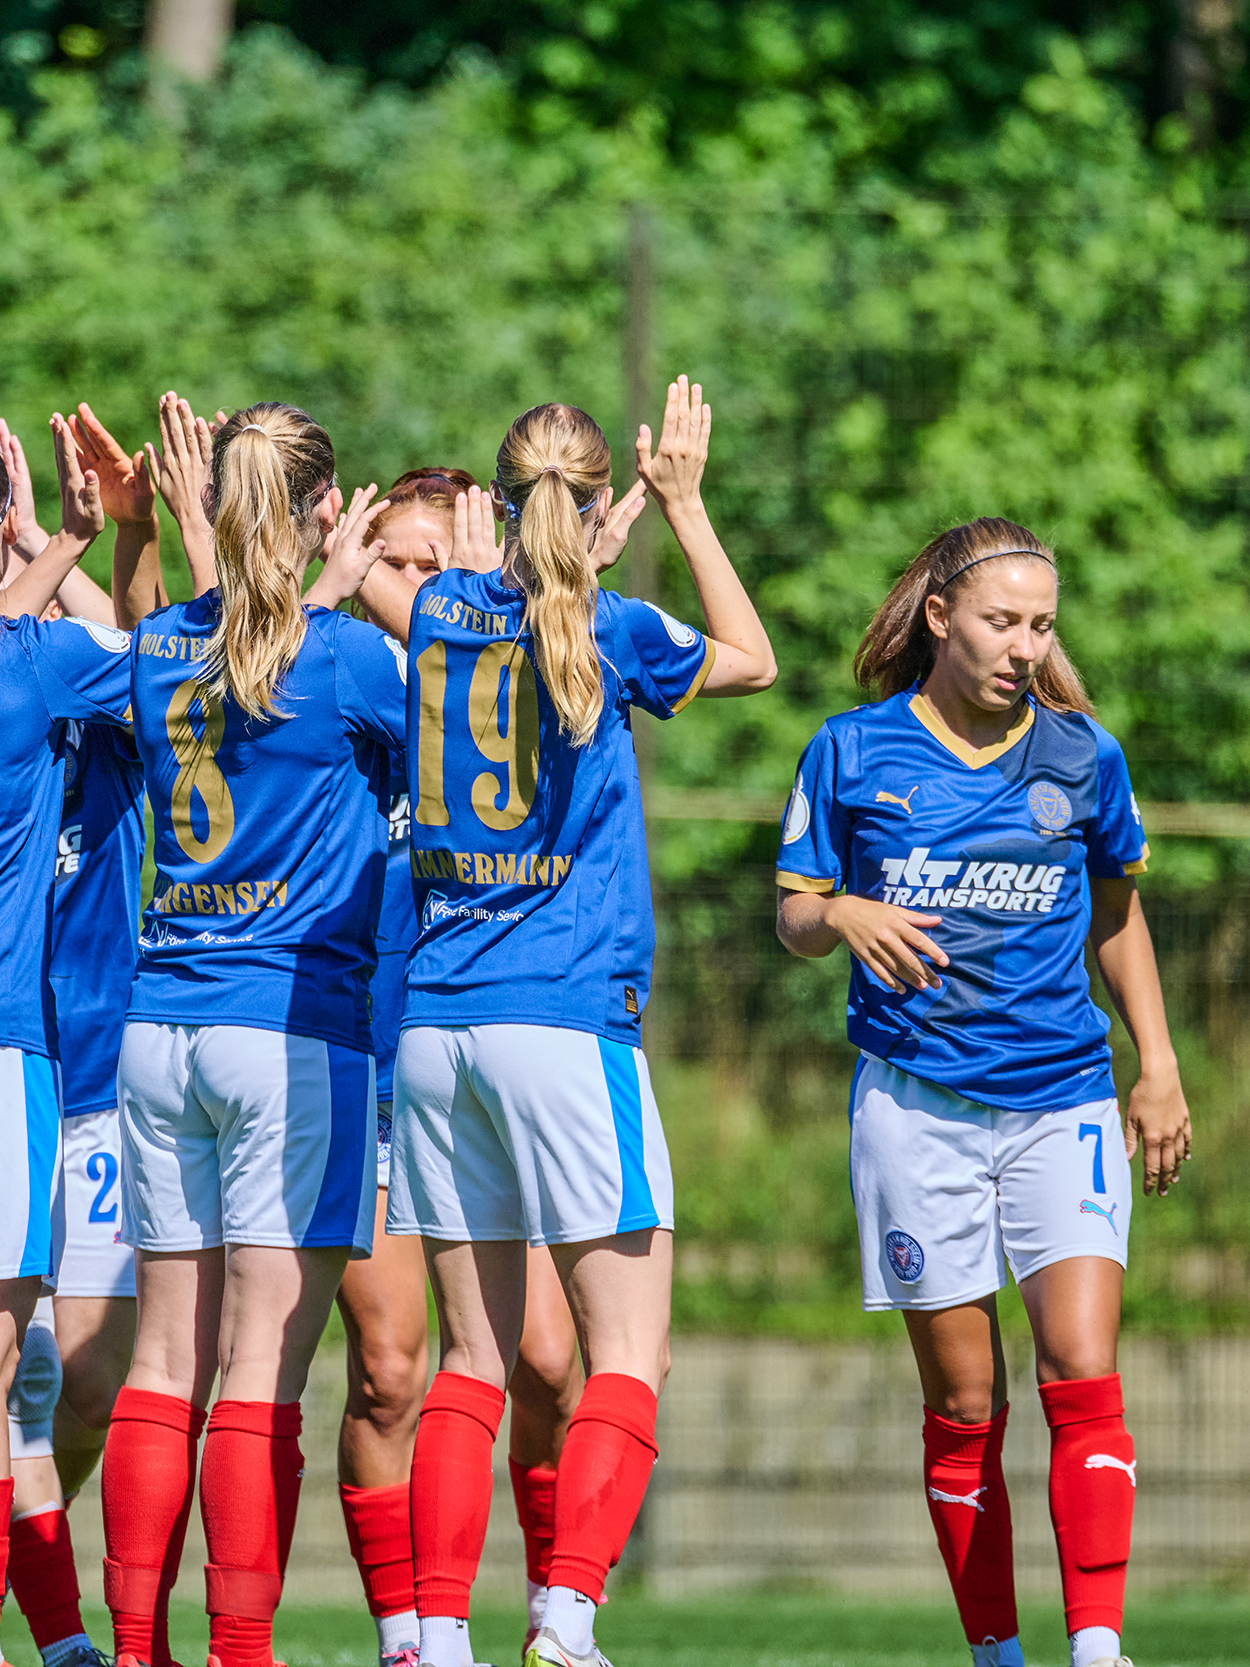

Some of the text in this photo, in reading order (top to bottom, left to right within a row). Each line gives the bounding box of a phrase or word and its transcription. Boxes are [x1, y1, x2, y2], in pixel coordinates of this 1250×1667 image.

[419, 593, 507, 636] HOLSTEIN
[414, 639, 540, 831] 19
[165, 678, 235, 864] 8
[410, 849, 573, 886] IMMERMANN
[959, 861, 1067, 893] KRUG
[882, 886, 1058, 913] TRANSPORTE
[86, 1151, 119, 1224] 2
[1078, 1122, 1107, 1195] 7
